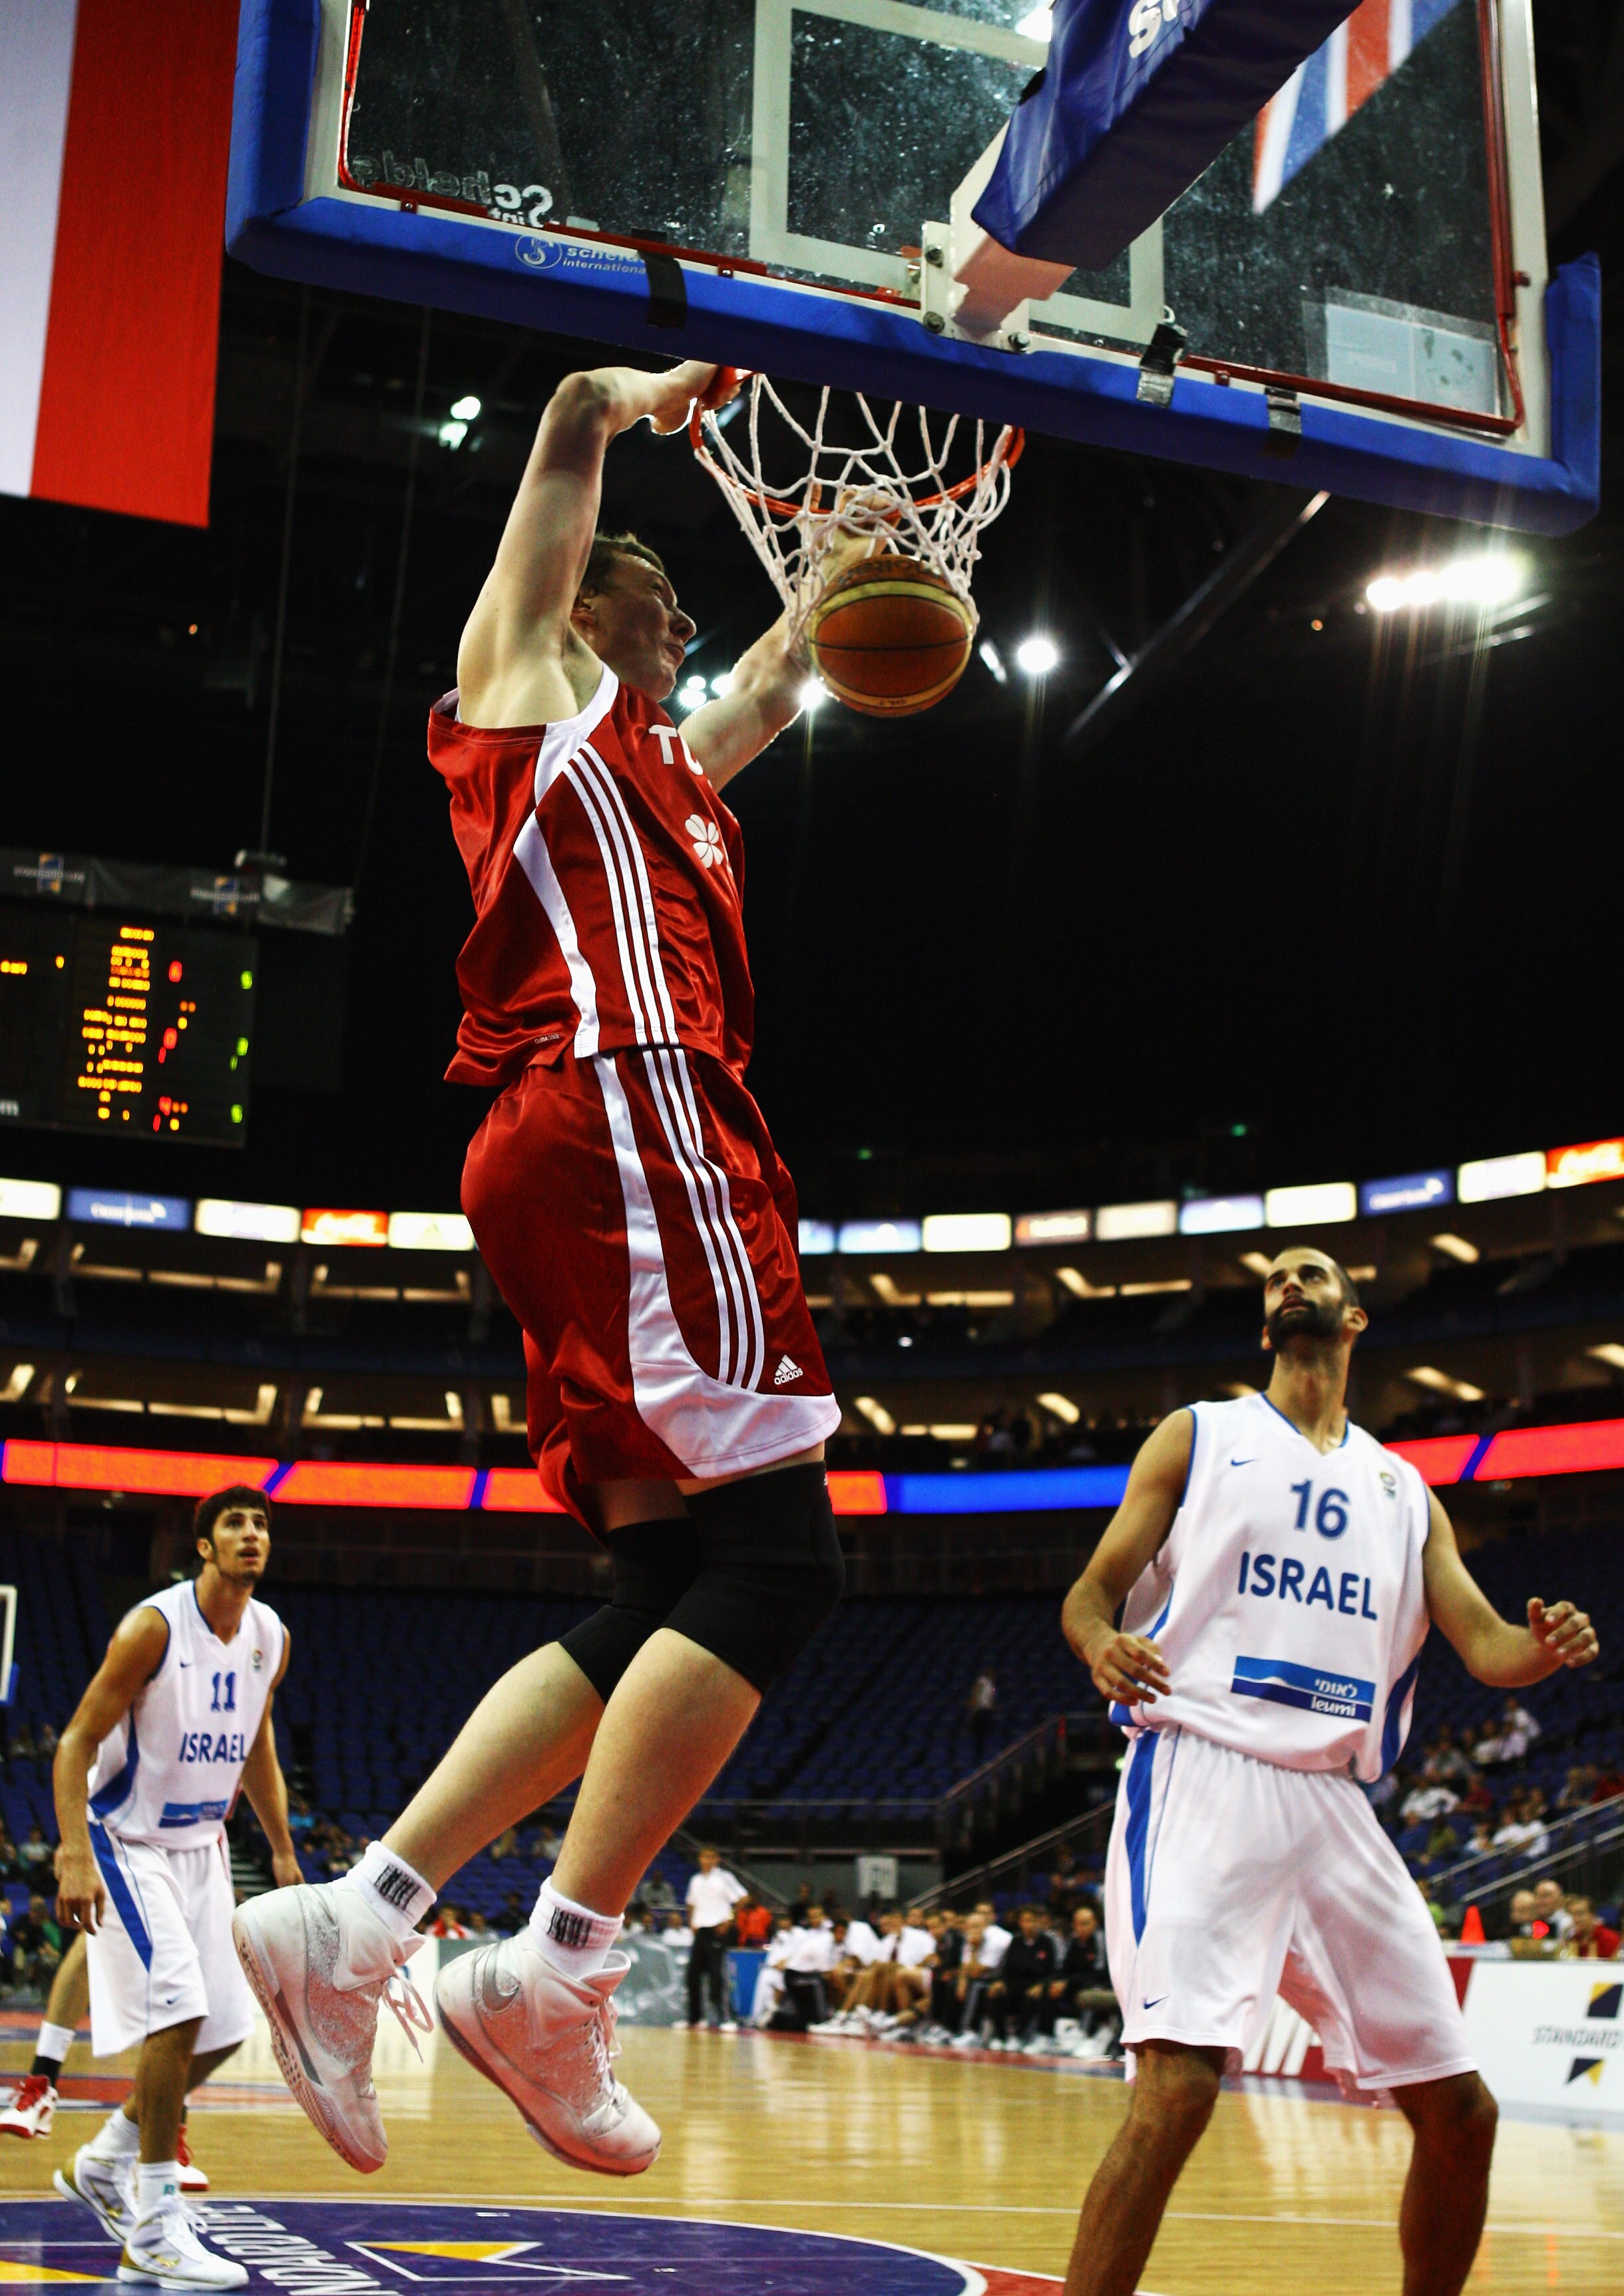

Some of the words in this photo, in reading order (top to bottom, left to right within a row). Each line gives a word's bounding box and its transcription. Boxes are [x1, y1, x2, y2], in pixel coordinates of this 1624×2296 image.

[562, 257, 646, 274] internationa
[774, 1368, 803, 1385] adidas
[1289, 1478, 1350, 1541] 16
[1238, 1551, 1378, 1621] ISRAEL
[210, 1672, 236, 1712] 11
[1314, 1678, 1358, 1698] לאומי
[1310, 1695, 1357, 1717] leumi
[178, 1732, 247, 1764] ISRAEL
[1533, 2025, 1623, 2048] STANDARD
